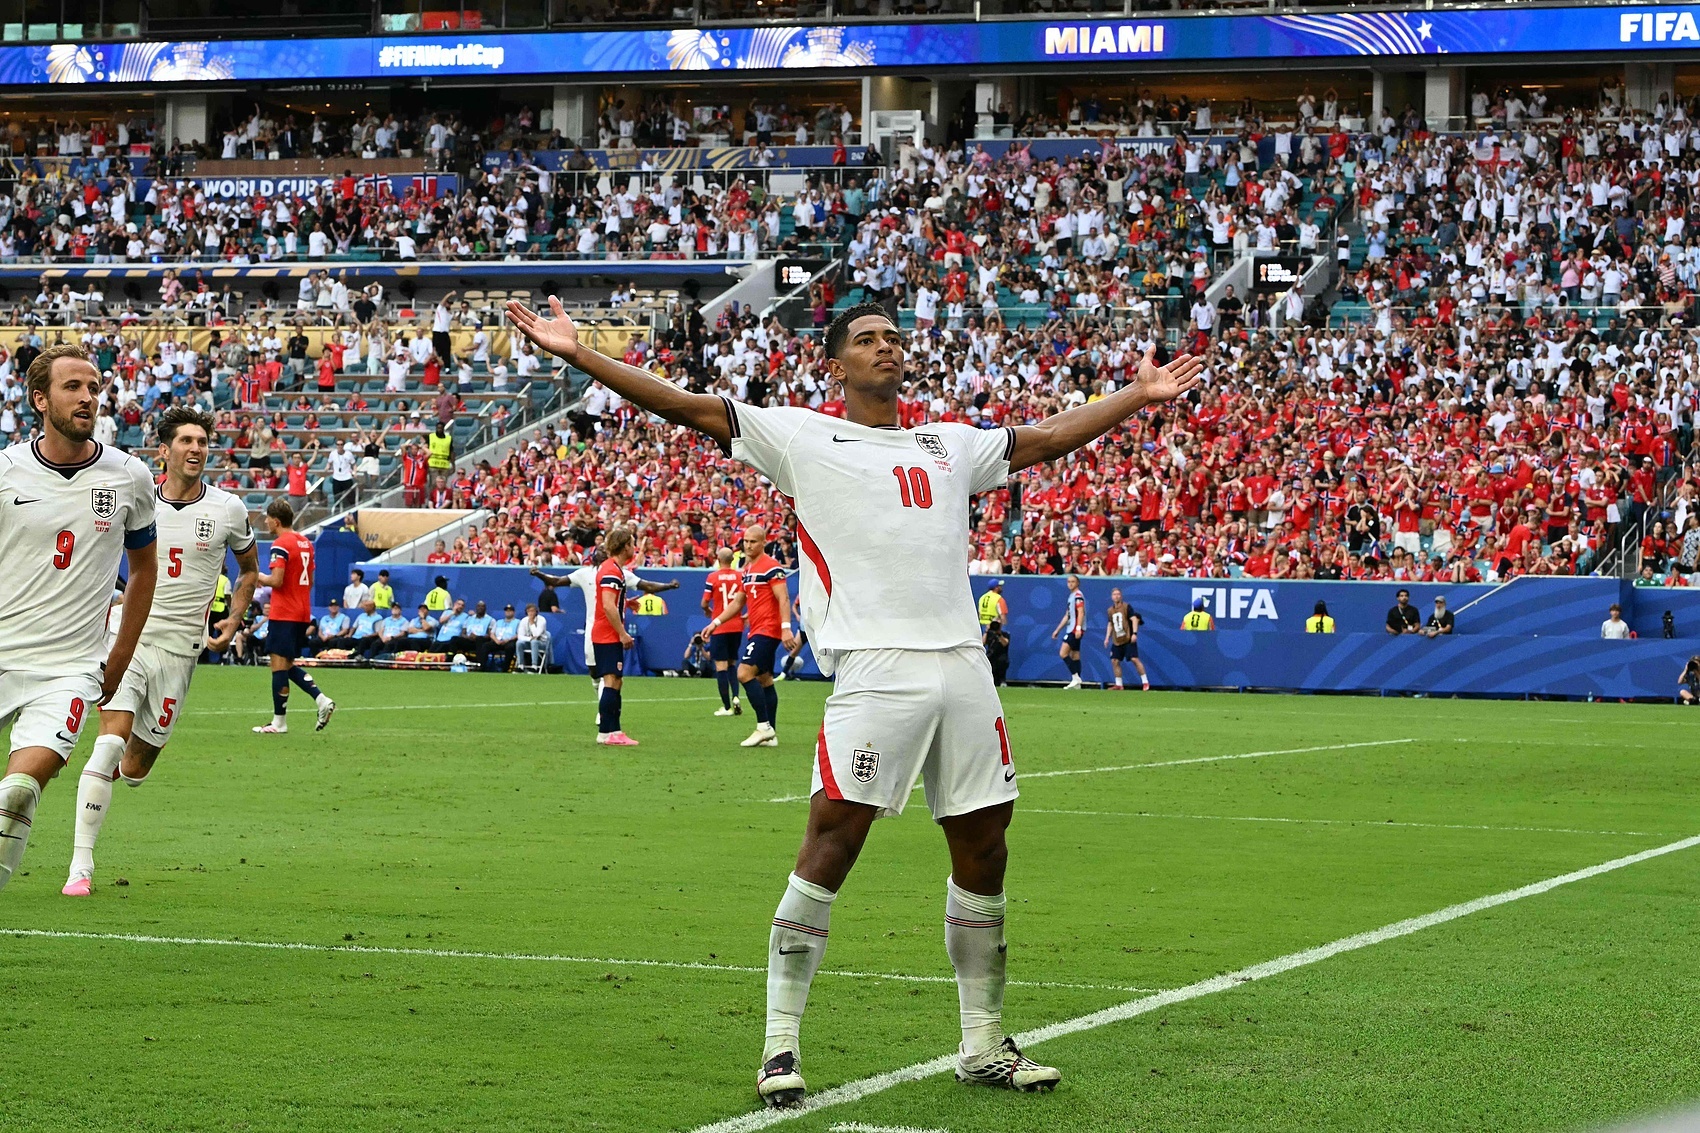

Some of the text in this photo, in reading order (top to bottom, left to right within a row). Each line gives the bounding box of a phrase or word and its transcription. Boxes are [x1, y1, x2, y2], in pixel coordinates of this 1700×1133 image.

[1045, 25, 1164, 54] MIAMI
[1620, 12, 1700, 42] FIFA
[379, 44, 504, 68] #FIFAWorldCup
[204, 179, 275, 198] WORLD
[892, 466, 933, 509] 10
[53, 531, 75, 570] 9
[167, 547, 183, 578] 5
[750, 585, 757, 599] 4
[1191, 587, 1279, 620] FIFA
[746, 642, 755, 656] 4
[66, 697, 84, 734] 9
[158, 697, 177, 728] 5
[86, 802, 102, 811] ENG
